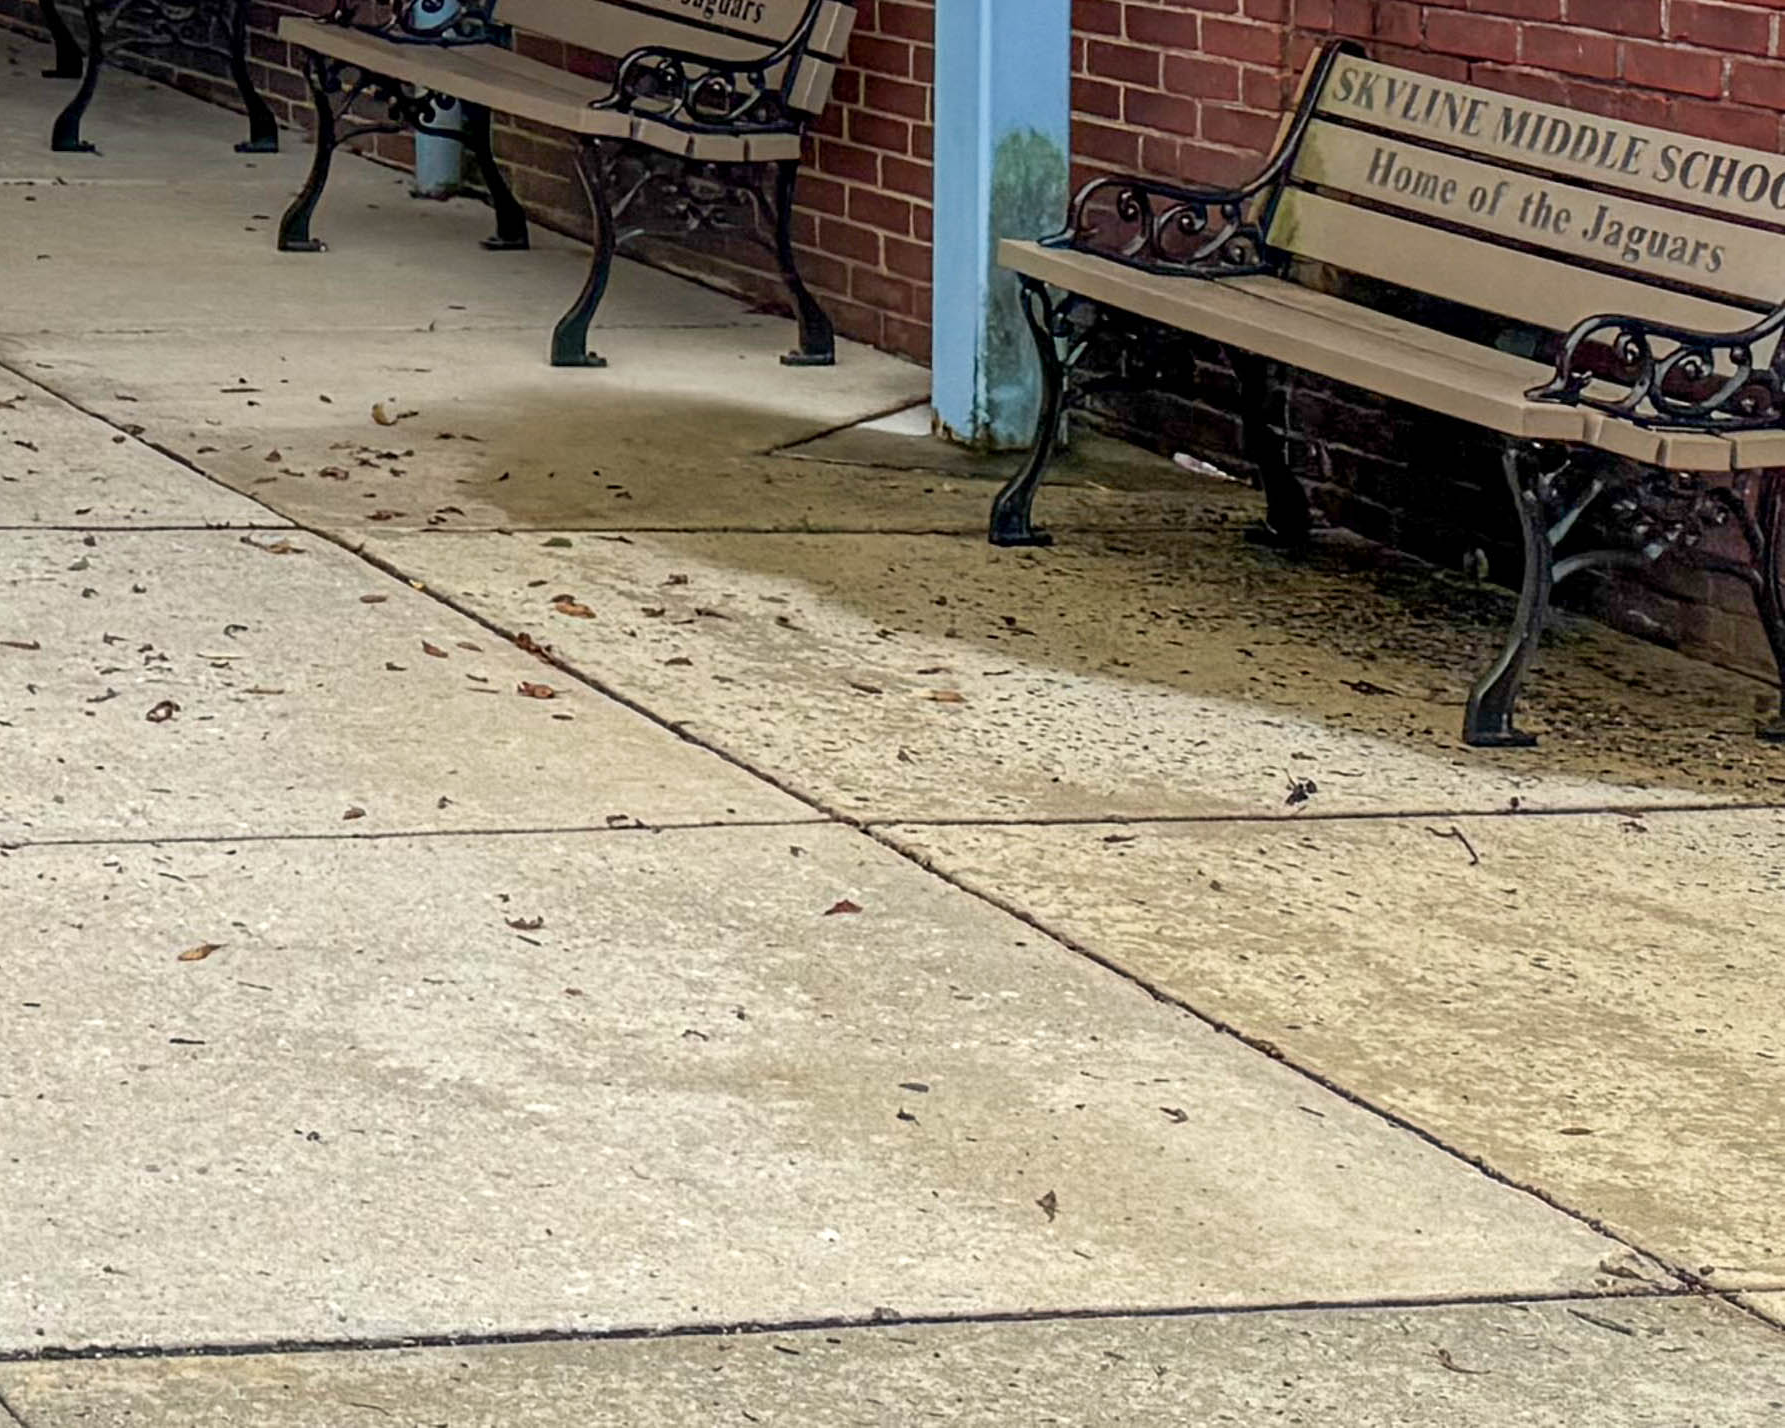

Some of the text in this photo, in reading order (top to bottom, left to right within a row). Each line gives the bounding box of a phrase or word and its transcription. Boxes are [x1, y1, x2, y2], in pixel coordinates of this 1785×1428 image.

[1332, 65, 1490, 138] SKYLINE
[1495, 104, 1652, 177] MIDDLE
[1365, 146, 1727, 275] Home of the Jaguars
